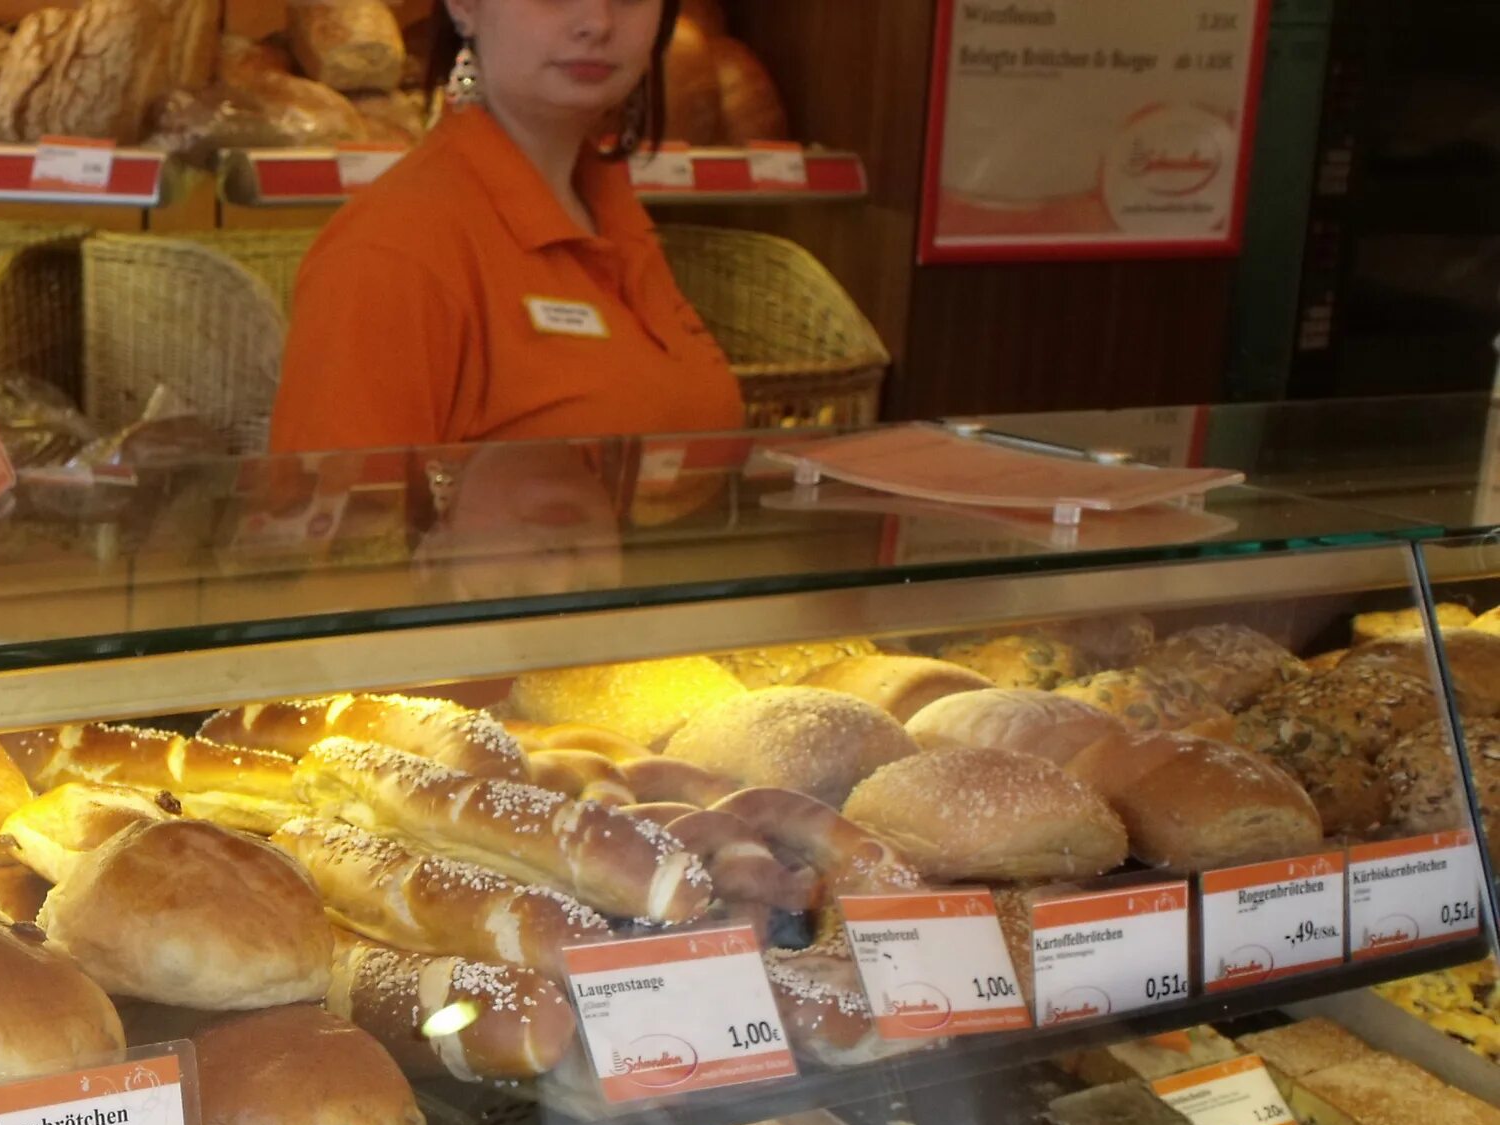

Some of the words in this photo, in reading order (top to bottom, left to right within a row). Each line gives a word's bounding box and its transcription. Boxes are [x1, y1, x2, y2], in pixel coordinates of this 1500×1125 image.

[1238, 880, 1325, 906] Roggenbrötchen
[852, 928, 920, 944] Laugenbrezel
[1035, 928, 1124, 951] Kartoffelbrötchen
[577, 975, 666, 999] Laugenstange
[728, 1020, 782, 1050] 1,00€
